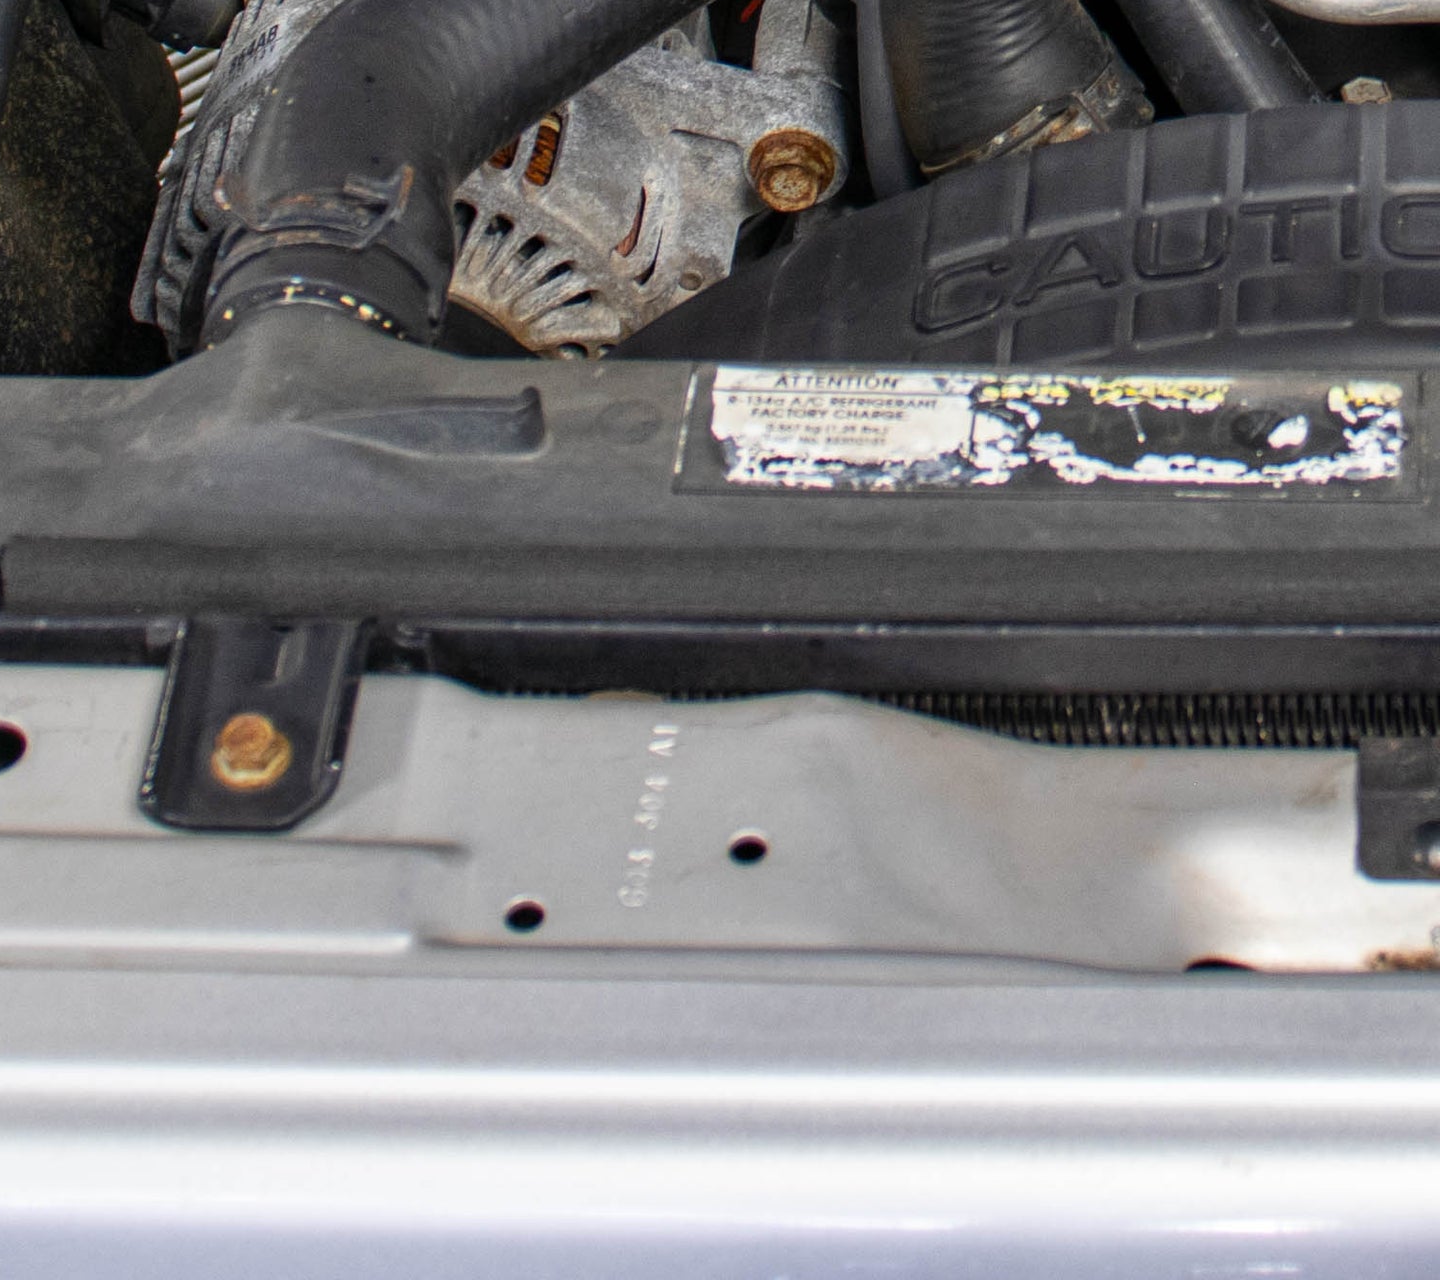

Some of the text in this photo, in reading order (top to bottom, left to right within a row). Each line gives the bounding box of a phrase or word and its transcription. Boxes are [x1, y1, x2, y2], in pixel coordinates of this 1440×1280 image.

[774, 374, 898, 390] ATTENTION
[829, 397, 938, 409] REFRIGERANT
[751, 408, 904, 421] FACTORY CHARGE
